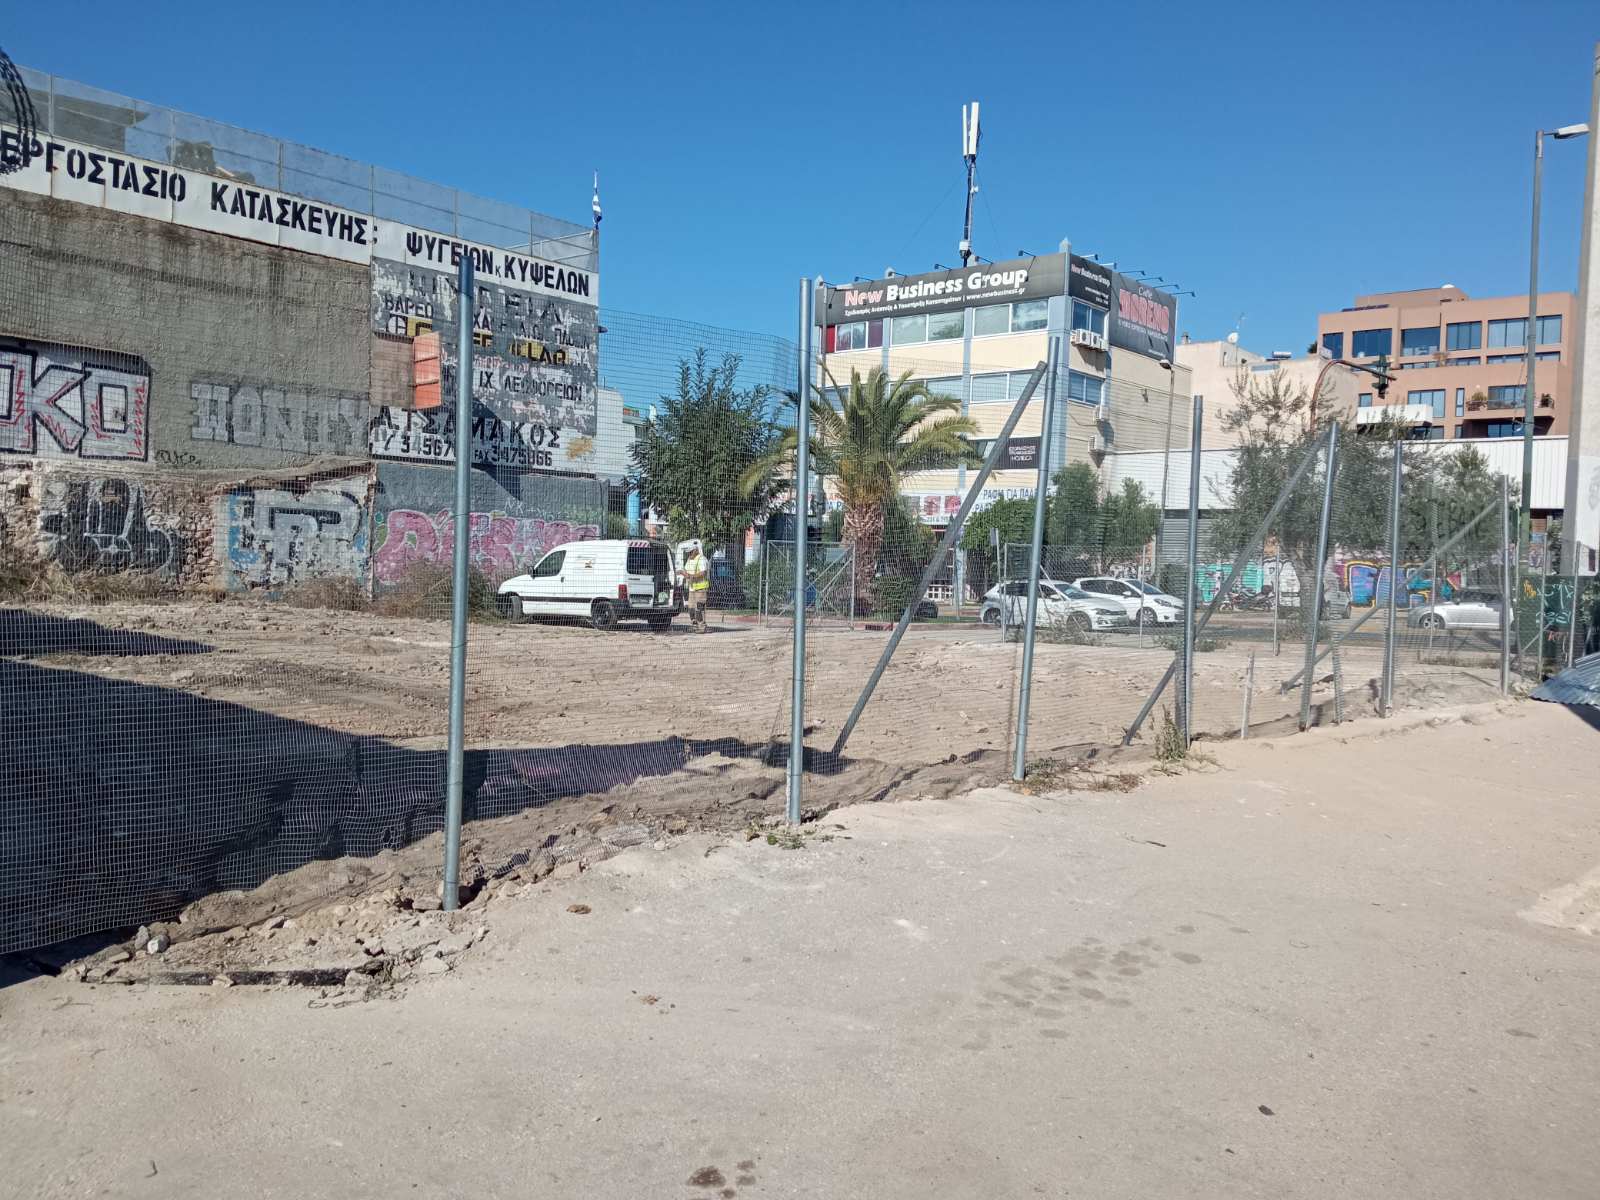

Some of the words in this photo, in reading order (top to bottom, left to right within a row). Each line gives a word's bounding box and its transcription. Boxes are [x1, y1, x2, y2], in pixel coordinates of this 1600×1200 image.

[1, 130, 187, 202] ΕΡΓΟΣΤΑΣΙΟ
[211, 181, 367, 245] ΚΑΤΑΣΚΕΥΗΣ
[504, 255, 590, 297] ΚΥΨΕΛΩΝ
[845, 290, 883, 306] New
[887, 280, 963, 301] Business
[967, 269, 1028, 289] Group
